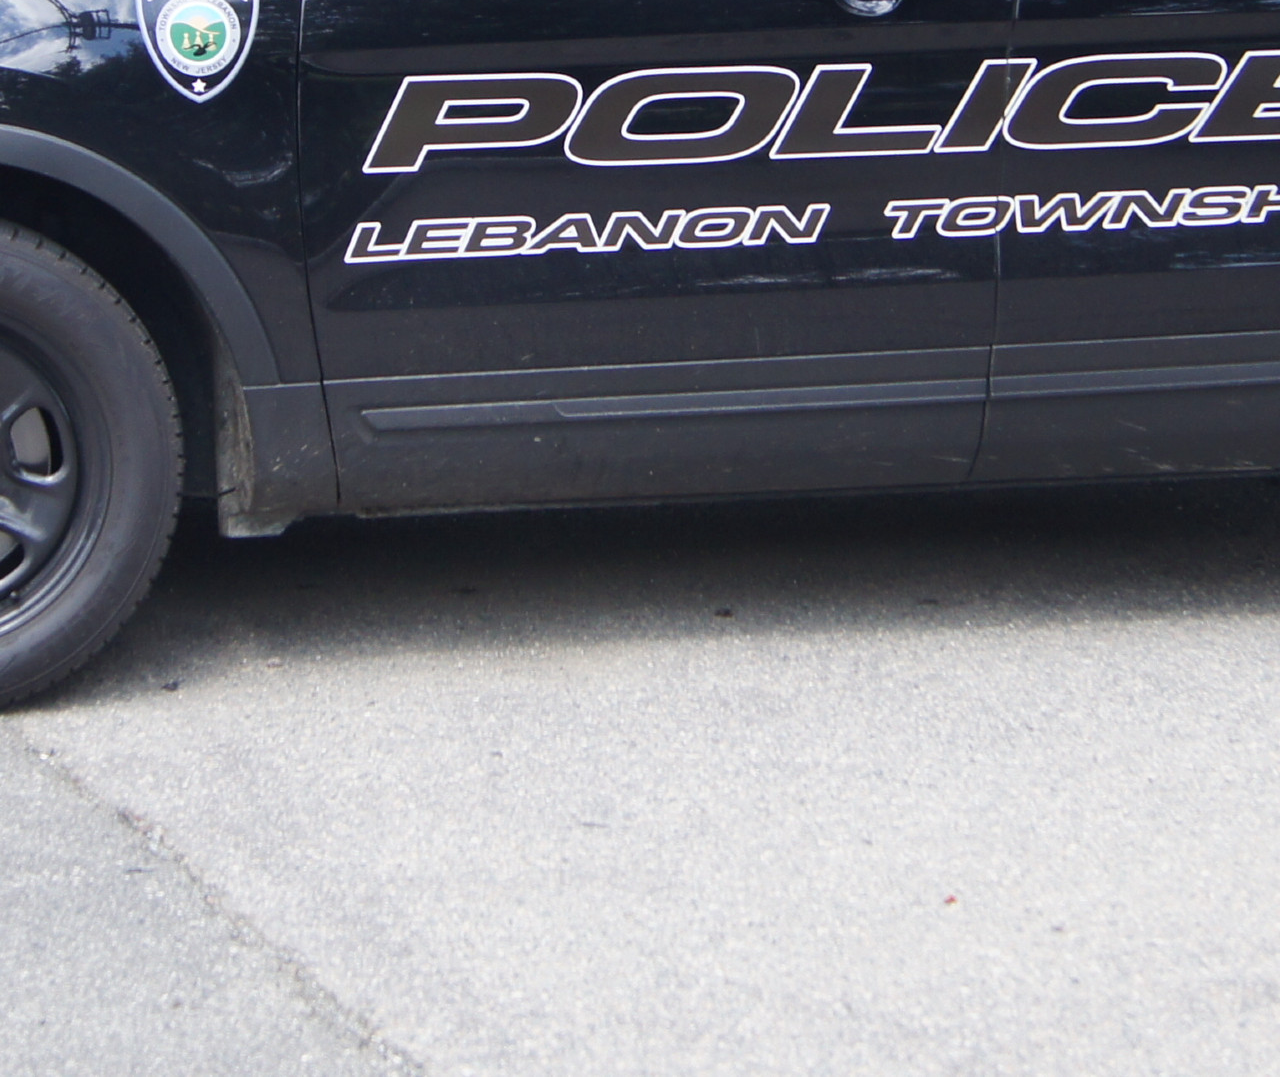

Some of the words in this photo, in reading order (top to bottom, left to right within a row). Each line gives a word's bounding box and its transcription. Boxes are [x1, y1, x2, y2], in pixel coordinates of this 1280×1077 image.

[171, 57, 190, 72] NEW
[195, 54, 228, 74] JERSEY
[344, 204, 830, 264] LEBANON
